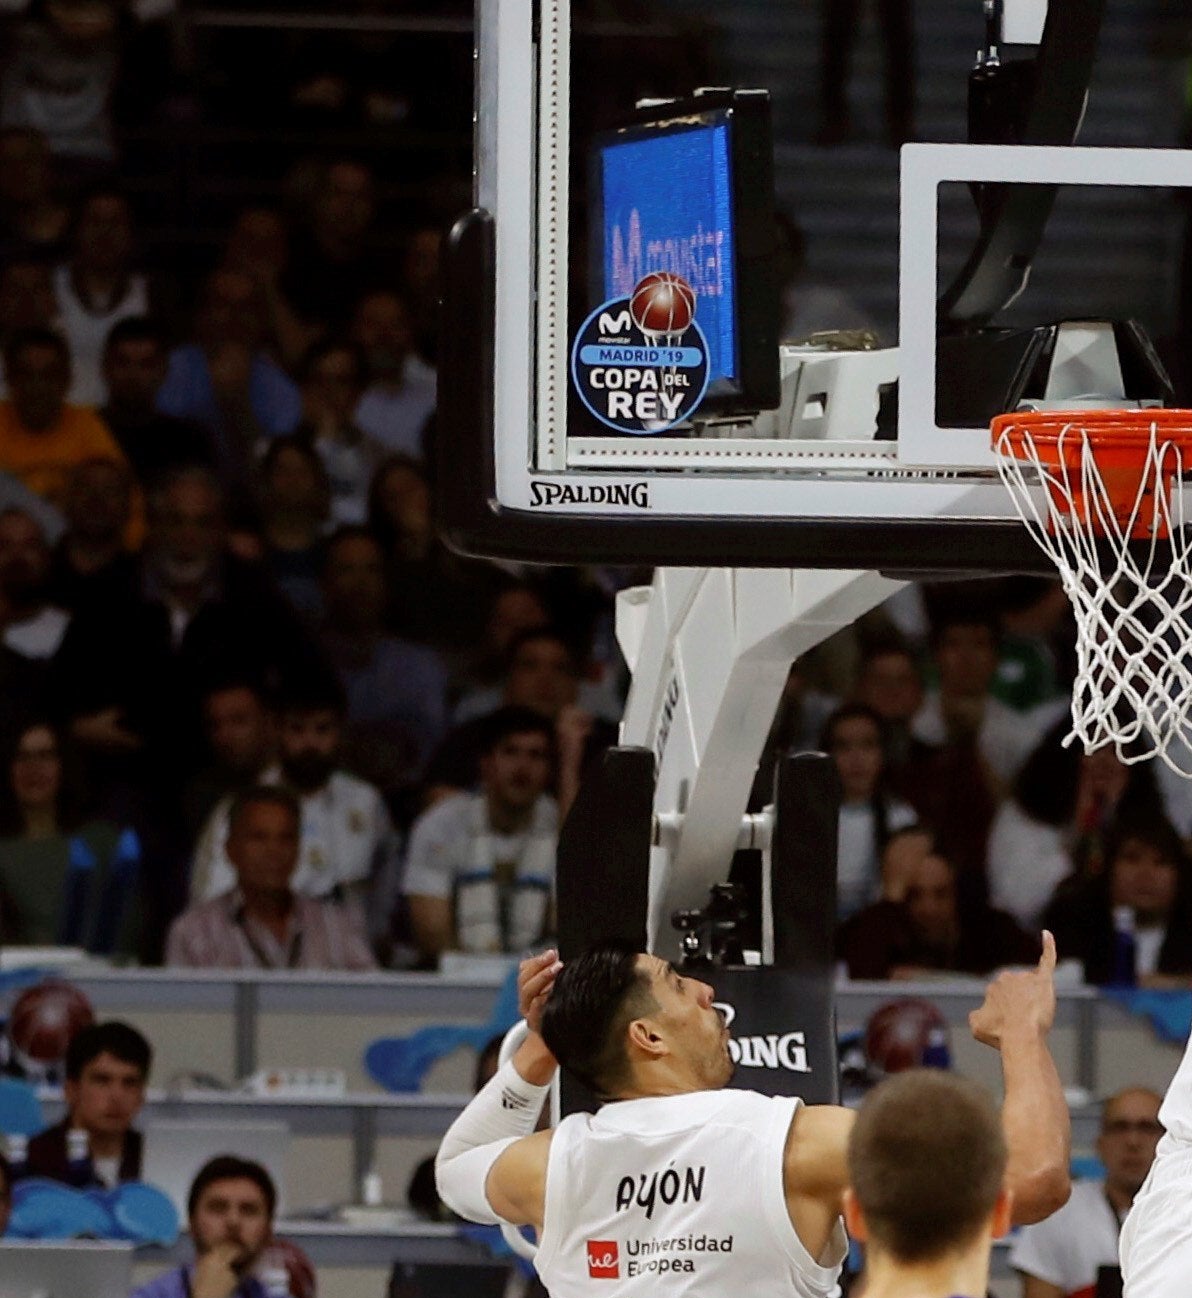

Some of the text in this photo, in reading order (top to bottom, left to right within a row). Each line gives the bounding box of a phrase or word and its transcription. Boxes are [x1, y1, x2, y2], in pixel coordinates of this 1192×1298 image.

[599, 350, 684, 363] MADRID '19
[589, 367, 690, 389] COPA DEL
[607, 391, 685, 419] REY
[530, 481, 648, 508] SPALDING
[616, 1160, 706, 1220] AYÓN
[626, 1234, 734, 1257] Universidad
